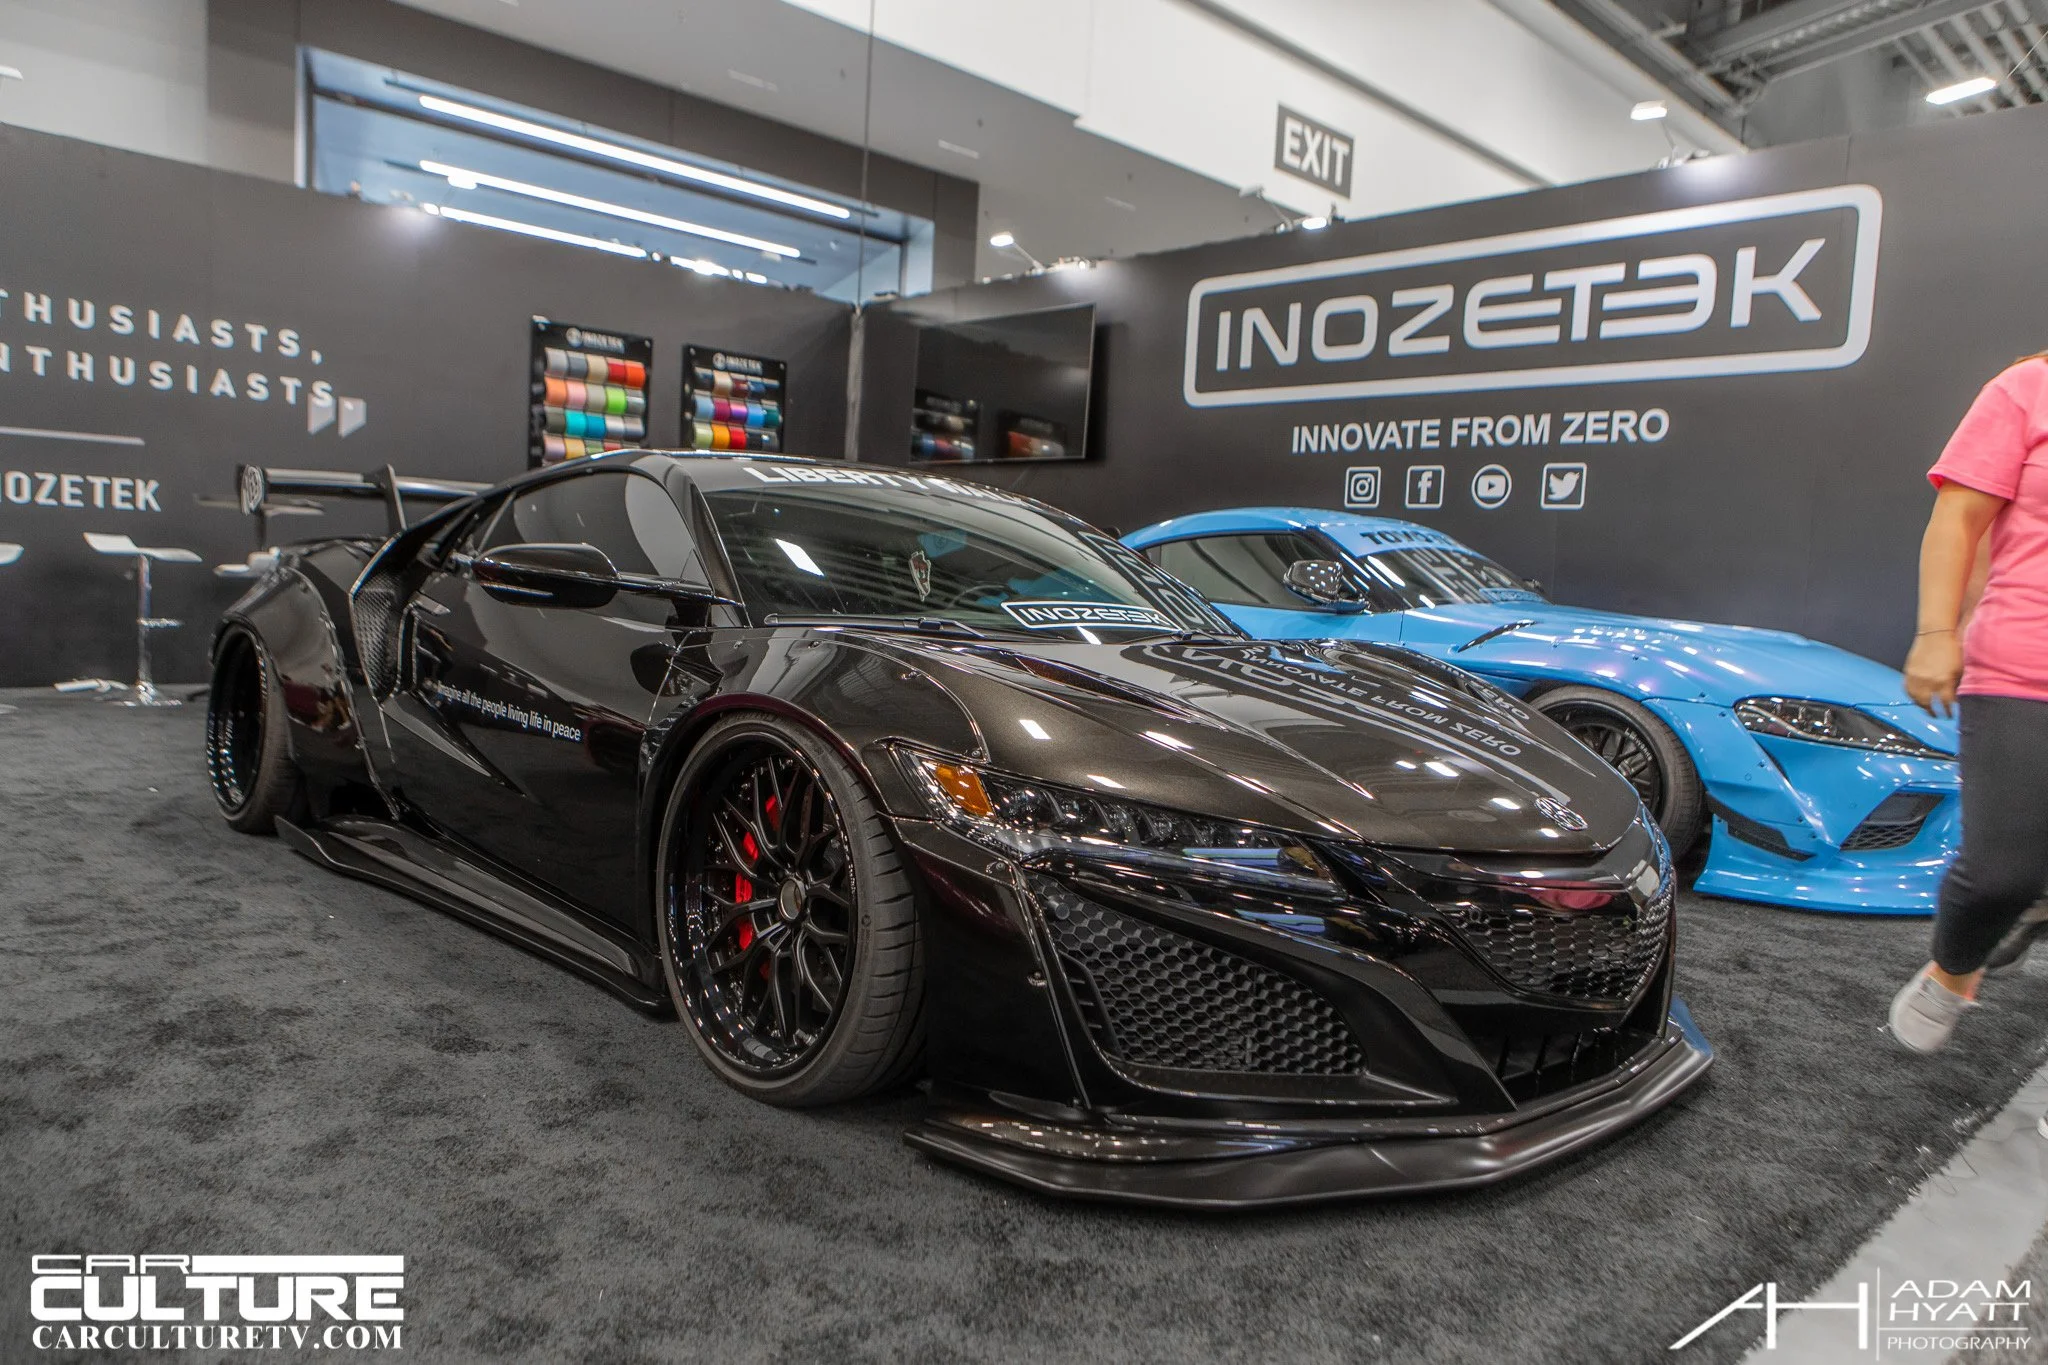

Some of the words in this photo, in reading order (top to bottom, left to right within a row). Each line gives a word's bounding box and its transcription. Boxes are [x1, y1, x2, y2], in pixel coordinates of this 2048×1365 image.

[1283, 116, 1350, 186] EXIT
[1216, 238, 1826, 372] INOZETEK
[1292, 419, 1440, 453] INNOVATE
[1451, 413, 1551, 447] FROM
[1560, 408, 1670, 445] ZERO
[0, 470, 161, 512] OZETEK
[742, 467, 929, 490] LIBERTY
[1019, 607, 1169, 626] INOZETEK
[481, 699, 507, 719] people
[507, 703, 528, 728] living
[529, 710, 542, 729] life
[543, 714, 552, 731] in
[552, 721, 581, 740] peace
